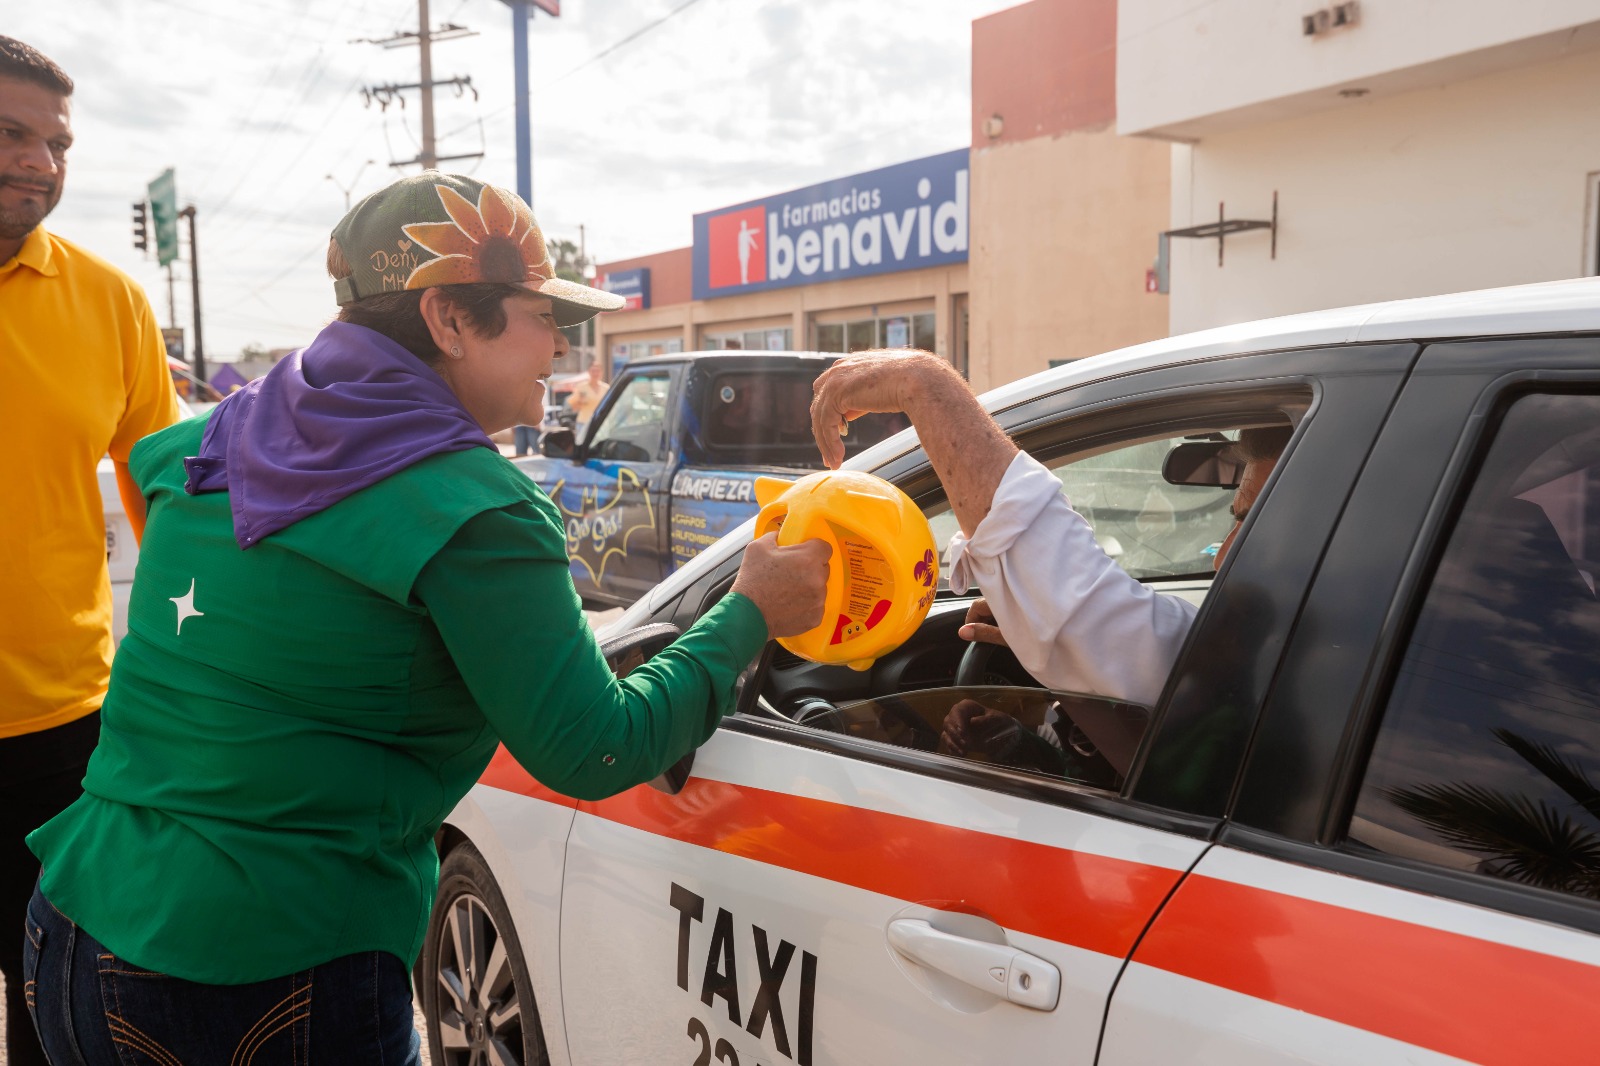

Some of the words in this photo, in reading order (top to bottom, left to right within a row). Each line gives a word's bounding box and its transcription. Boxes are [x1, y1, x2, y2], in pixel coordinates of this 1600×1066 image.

[782, 187, 882, 230] farmacias
[370, 249, 419, 273] Deny
[382, 273, 408, 291] MH
[671, 473, 753, 503] LIMPIEZA
[675, 514, 707, 529] CARROS
[669, 881, 818, 1066] TAXI
